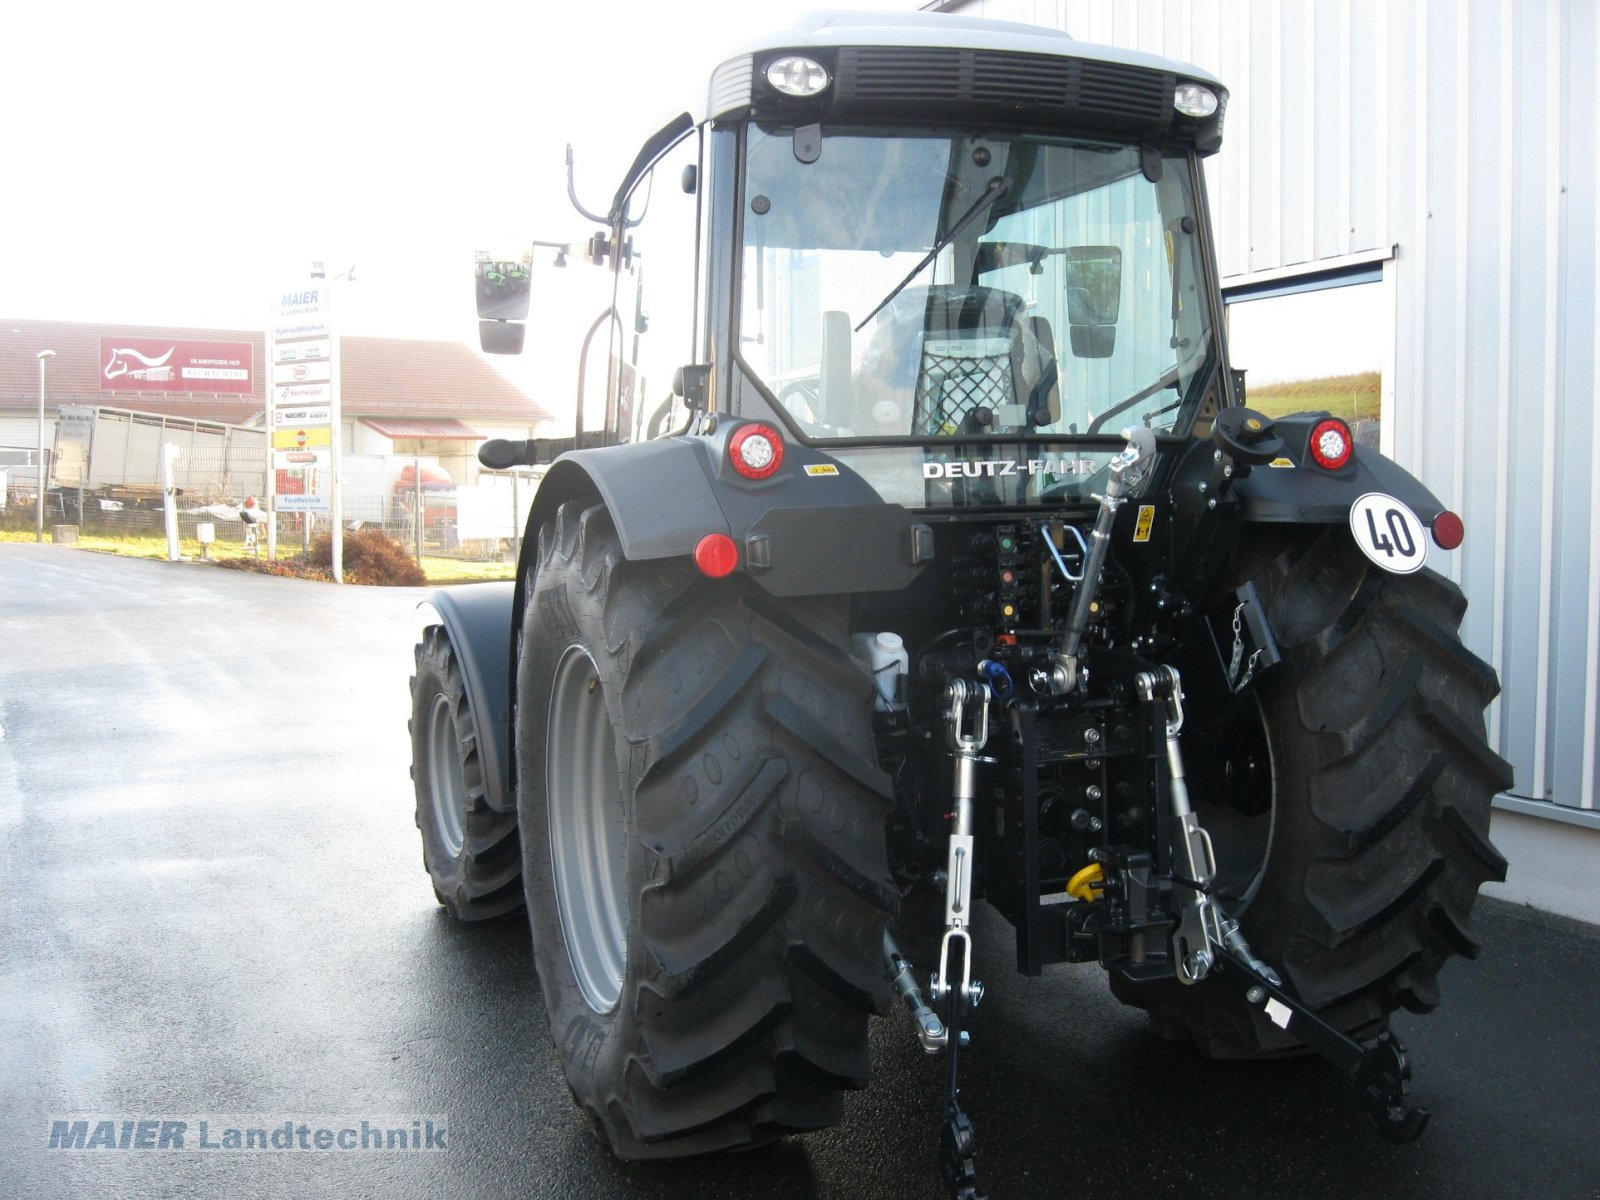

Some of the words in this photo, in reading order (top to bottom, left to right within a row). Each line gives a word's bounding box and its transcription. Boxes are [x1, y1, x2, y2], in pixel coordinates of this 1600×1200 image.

[282, 290, 319, 306] MAIER
[923, 459, 1097, 479] DEUTZ-FAHR
[1365, 508, 1416, 557] 40
